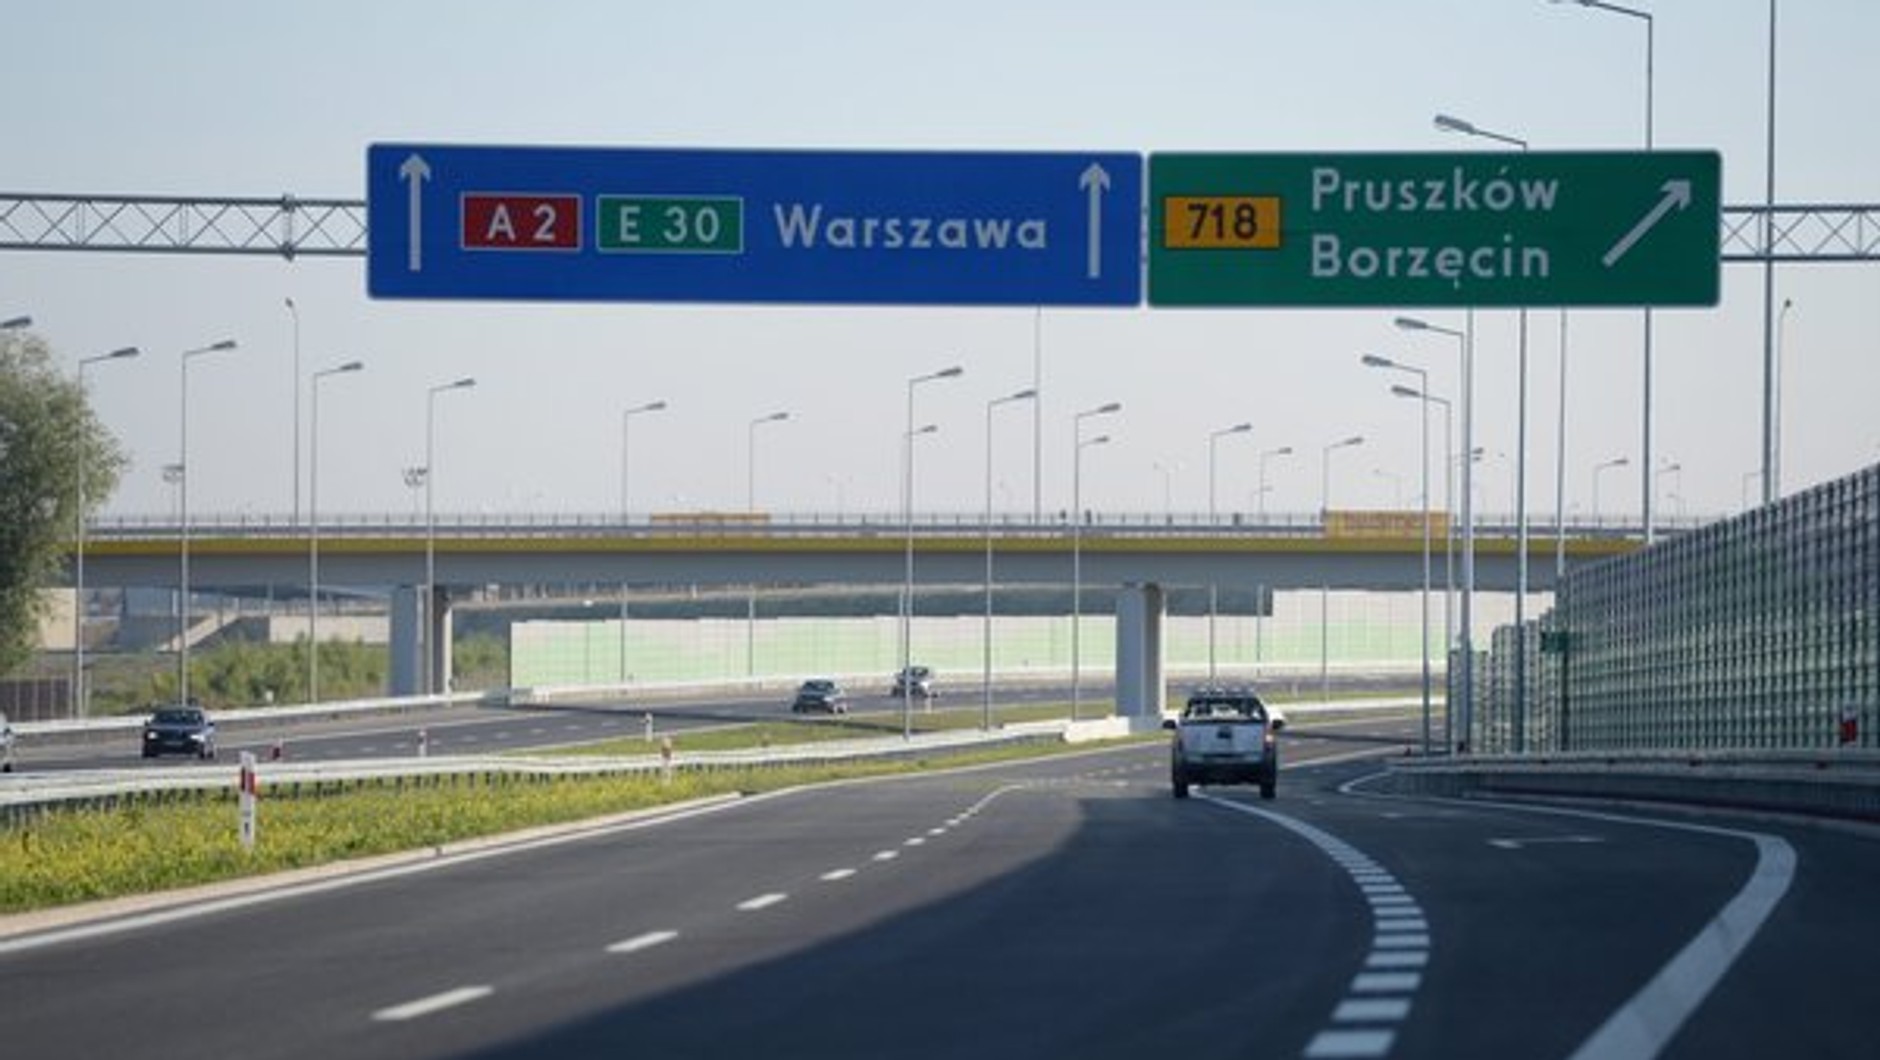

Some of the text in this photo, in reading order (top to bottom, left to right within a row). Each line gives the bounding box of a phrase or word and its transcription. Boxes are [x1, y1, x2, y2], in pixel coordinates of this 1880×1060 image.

[1311, 166, 1559, 212] Pruszków
[487, 203, 557, 241] A 2
[619, 205, 720, 243] E 30
[773, 202, 1047, 249] Warszawa
[1187, 203, 1259, 240] 718
[1311, 233, 1550, 289] Borzęcin
